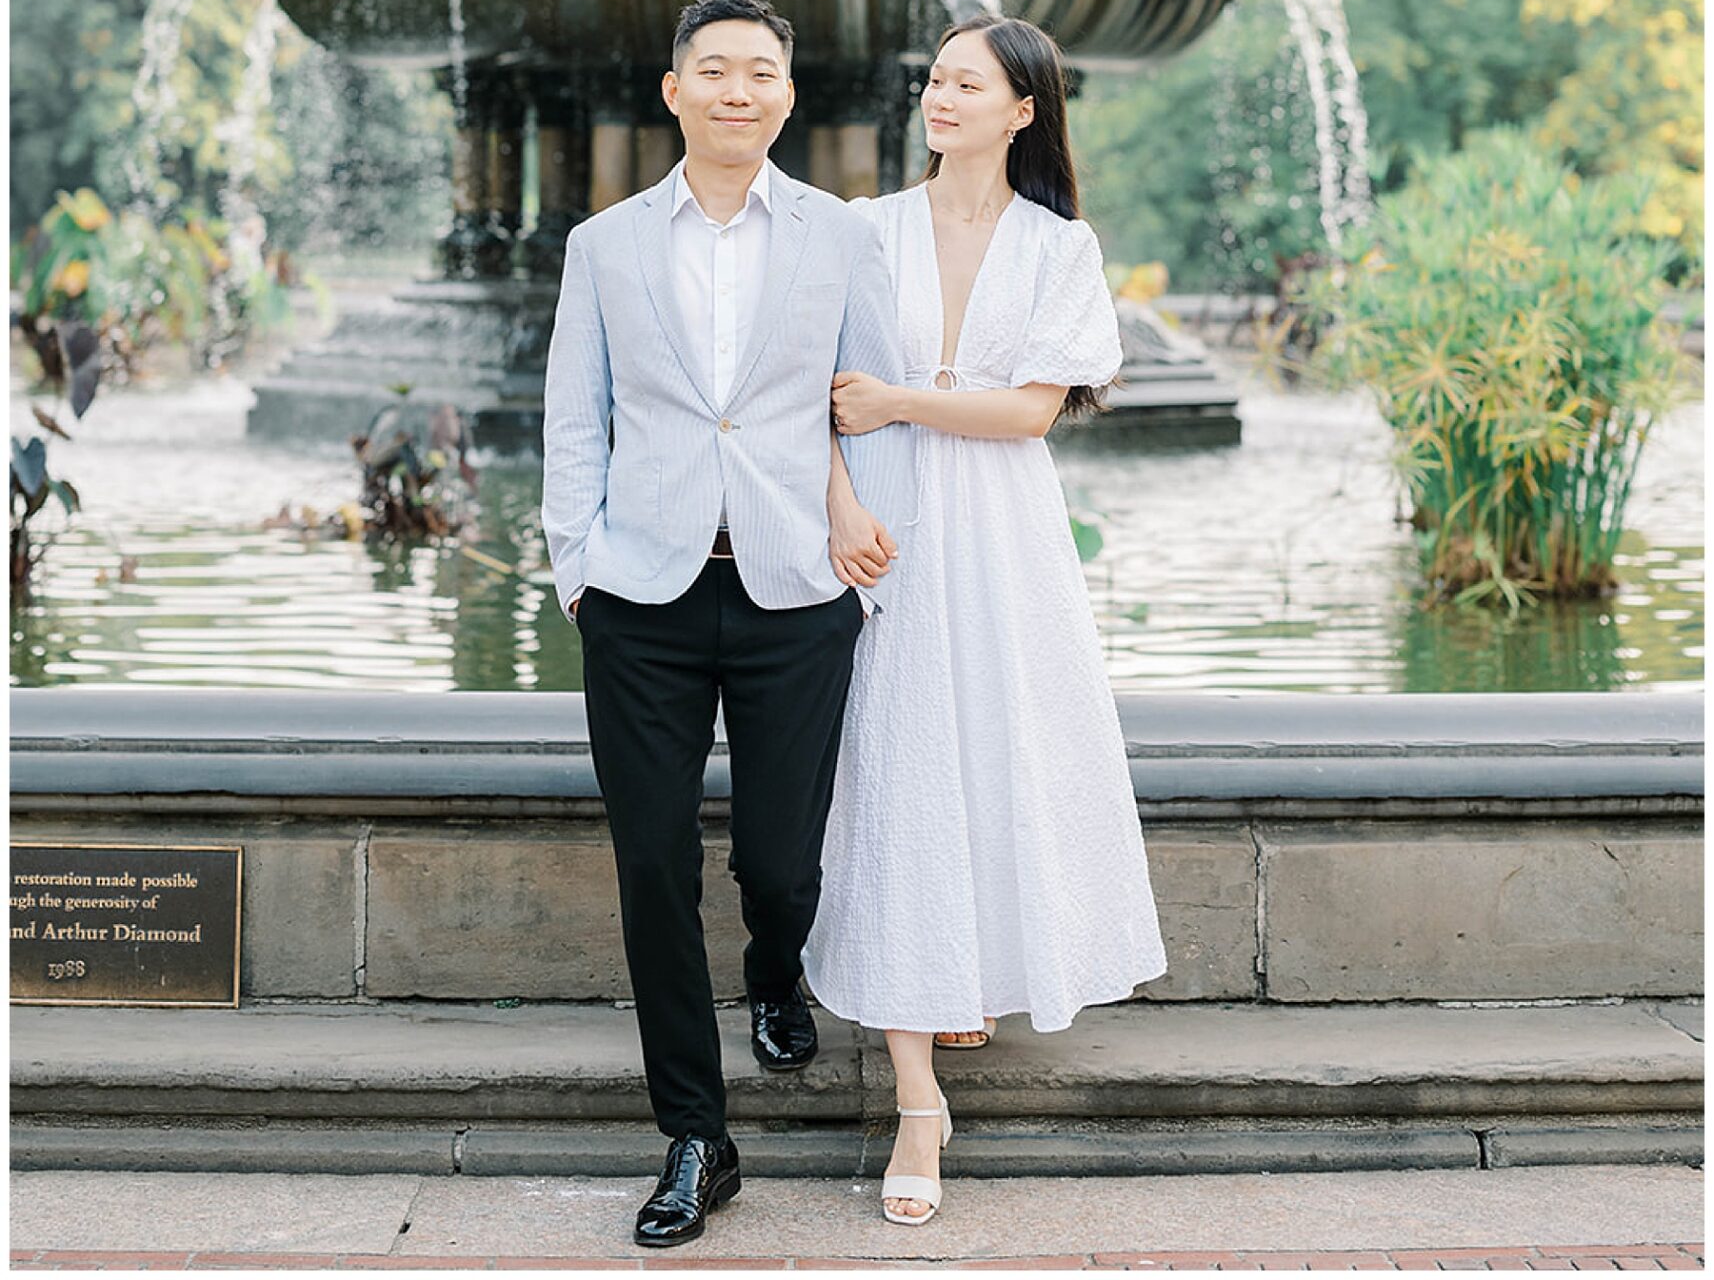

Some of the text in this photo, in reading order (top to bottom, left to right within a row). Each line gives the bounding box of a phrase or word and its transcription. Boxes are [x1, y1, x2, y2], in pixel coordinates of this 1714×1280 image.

[14, 871, 198, 891] restoration made possible
[39, 892, 62, 908] the
[64, 894, 140, 913] generosity
[142, 894, 160, 910] of
[10, 920, 202, 943] nd Arthur Diamond
[48, 960, 85, 979] 1988
